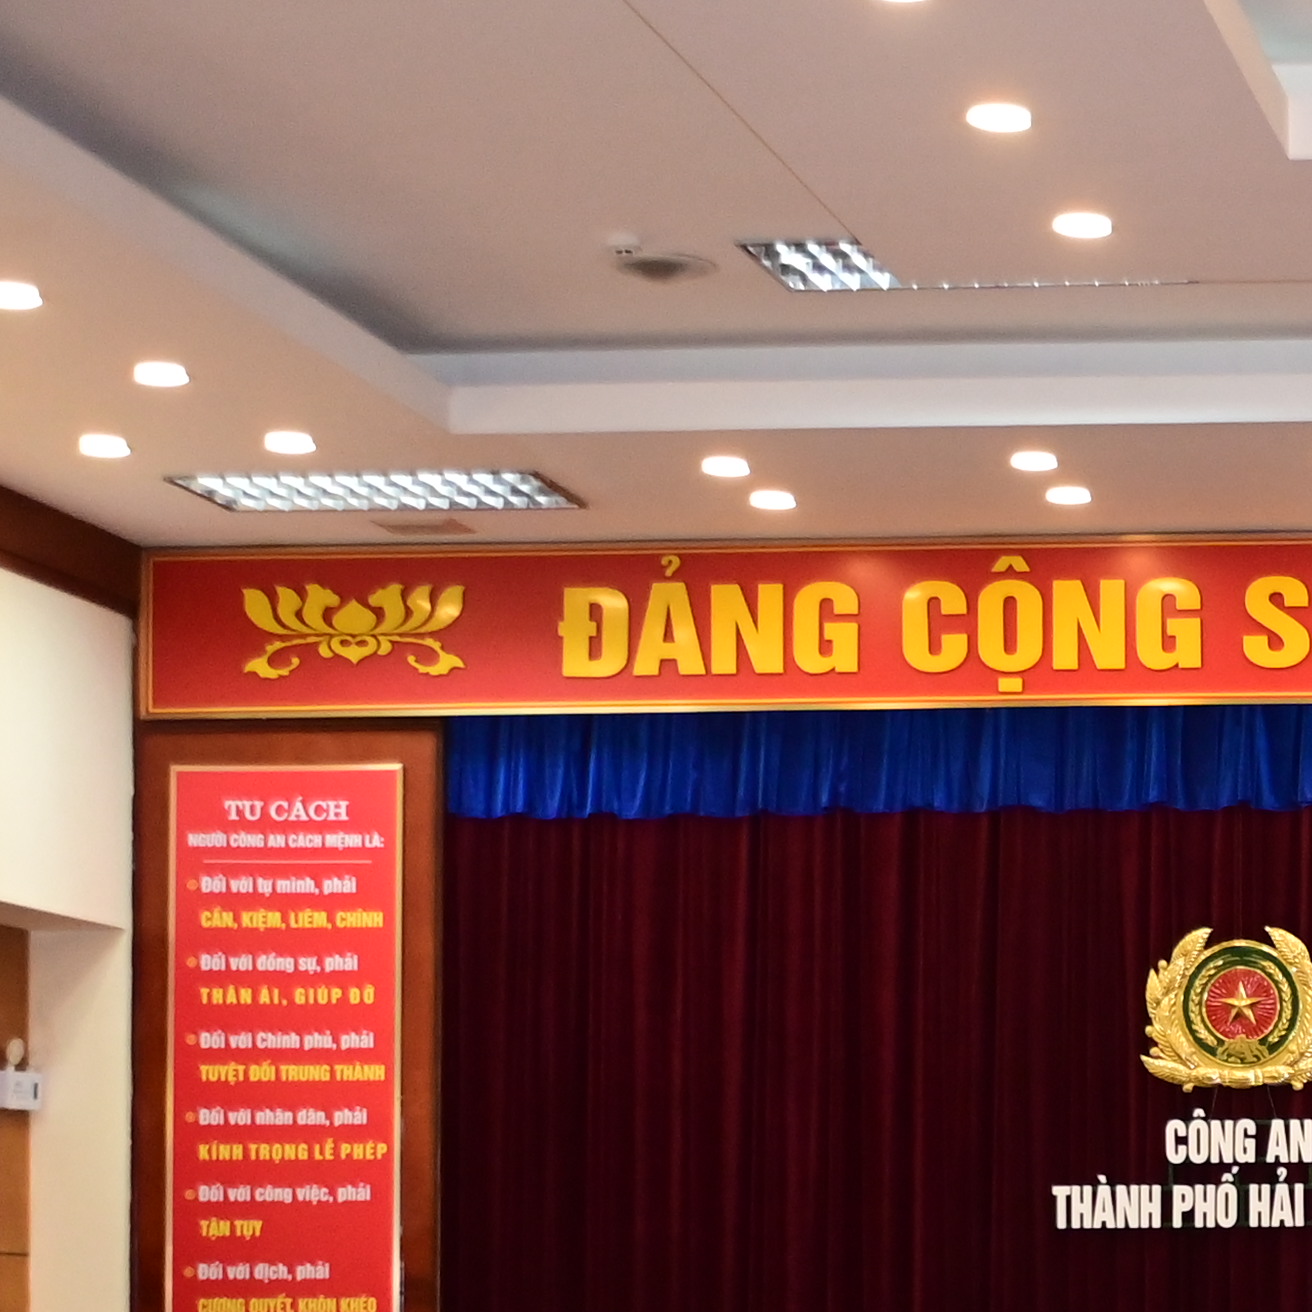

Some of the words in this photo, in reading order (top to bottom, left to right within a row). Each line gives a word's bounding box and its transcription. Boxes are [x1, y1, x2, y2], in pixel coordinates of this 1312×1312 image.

[558, 554, 859, 678] ĐẢNG
[901, 554, 1202, 692] CỘNG
[270, 796, 349, 820] CÁCH
[267, 834, 286, 847] AN
[281, 1065, 330, 1081] TRUNG
[1165, 1108, 1256, 1164] CÔNG
[1265, 1119, 1312, 1163] AN
[199, 1141, 243, 1161] KÍNH
[250, 1144, 308, 1163] TRỌNG
[315, 1138, 334, 1160] LỄ
[341, 1141, 388, 1159] PHÉP
[1052, 1174, 1161, 1229] THÀNH
[1172, 1166, 1239, 1228] PHỐ
[1249, 1167, 1304, 1228] HẢI
